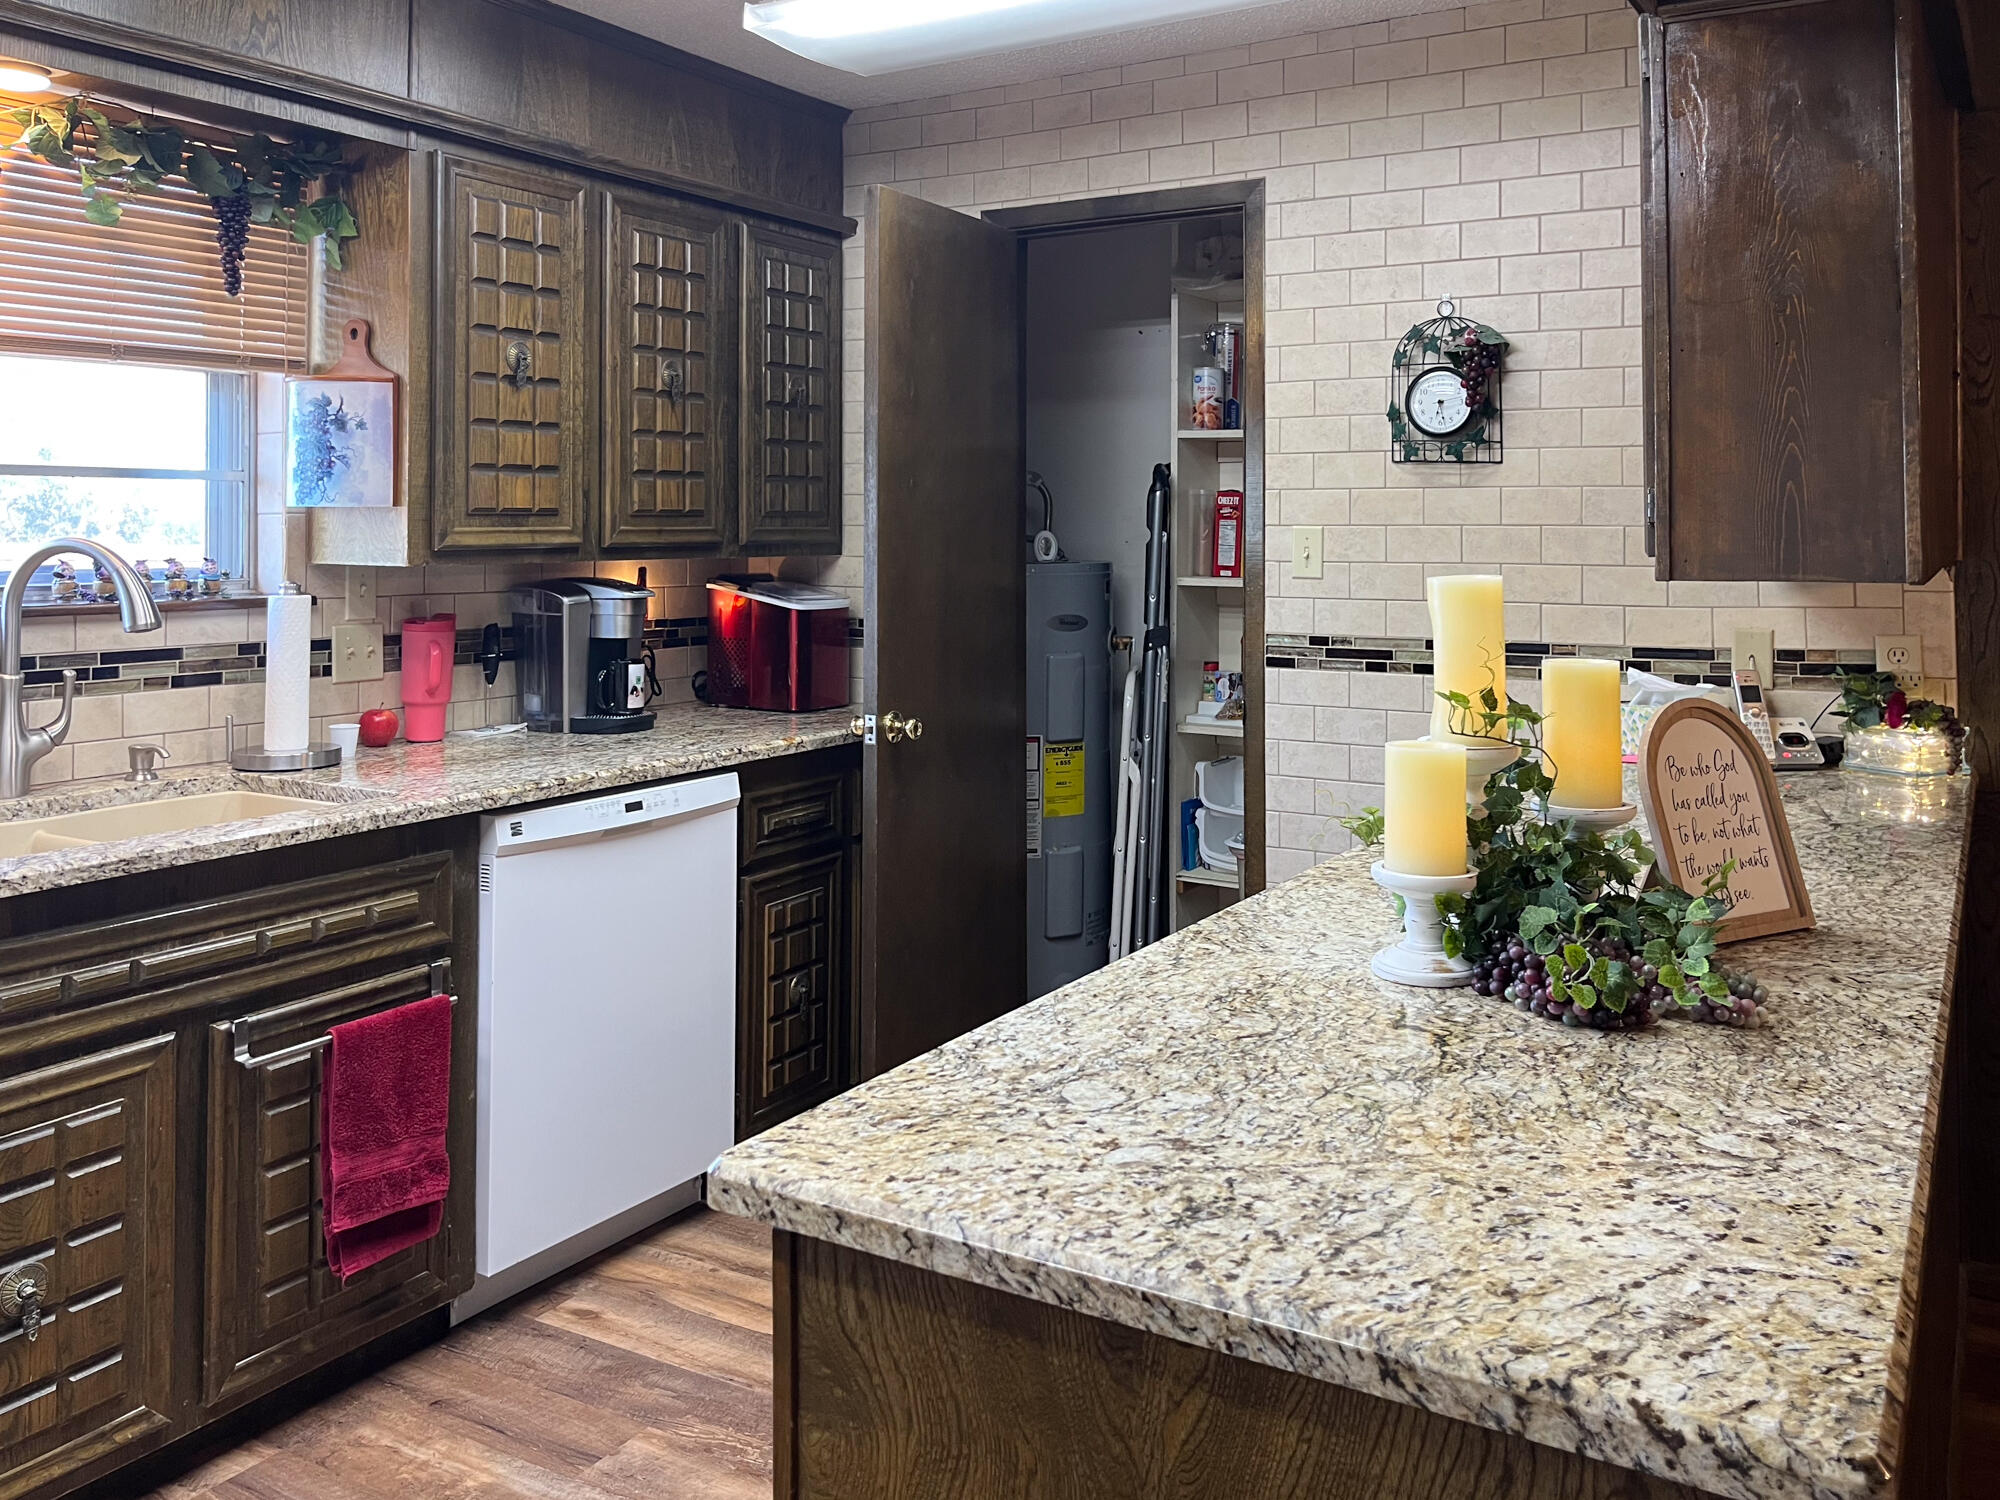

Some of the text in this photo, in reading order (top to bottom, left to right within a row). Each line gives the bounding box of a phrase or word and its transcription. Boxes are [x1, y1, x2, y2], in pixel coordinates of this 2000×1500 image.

[1664, 748, 1739, 782] Be who God
[1671, 783, 1750, 816] has called you
[1673, 813, 1761, 846] to be, not what
[1680, 846, 1769, 879] the wol wants
[1734, 888, 1755, 903] see.
